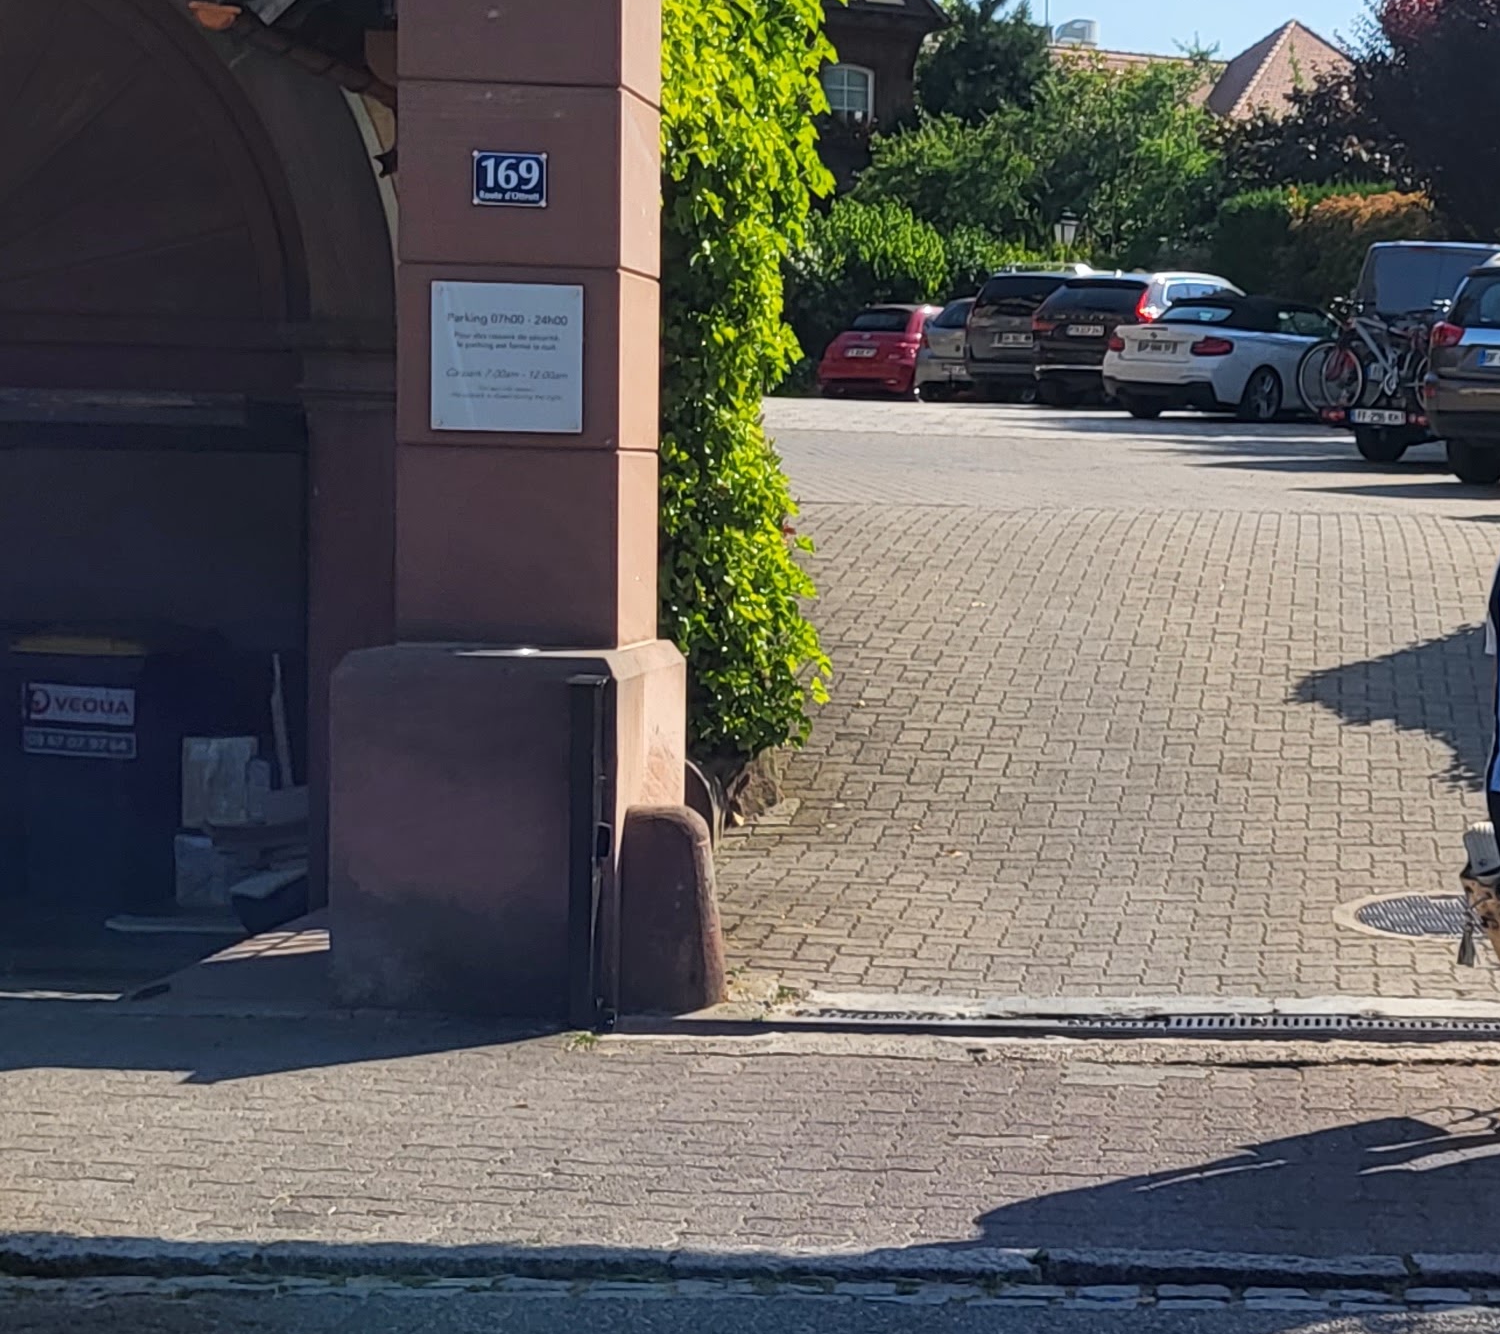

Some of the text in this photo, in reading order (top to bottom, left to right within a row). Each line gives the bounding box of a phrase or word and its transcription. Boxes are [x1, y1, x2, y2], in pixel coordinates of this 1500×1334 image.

[481, 157, 540, 190] 169
[448, 312, 488, 326] Parking
[491, 313, 525, 325] 07h00
[534, 314, 568, 326] 24h00
